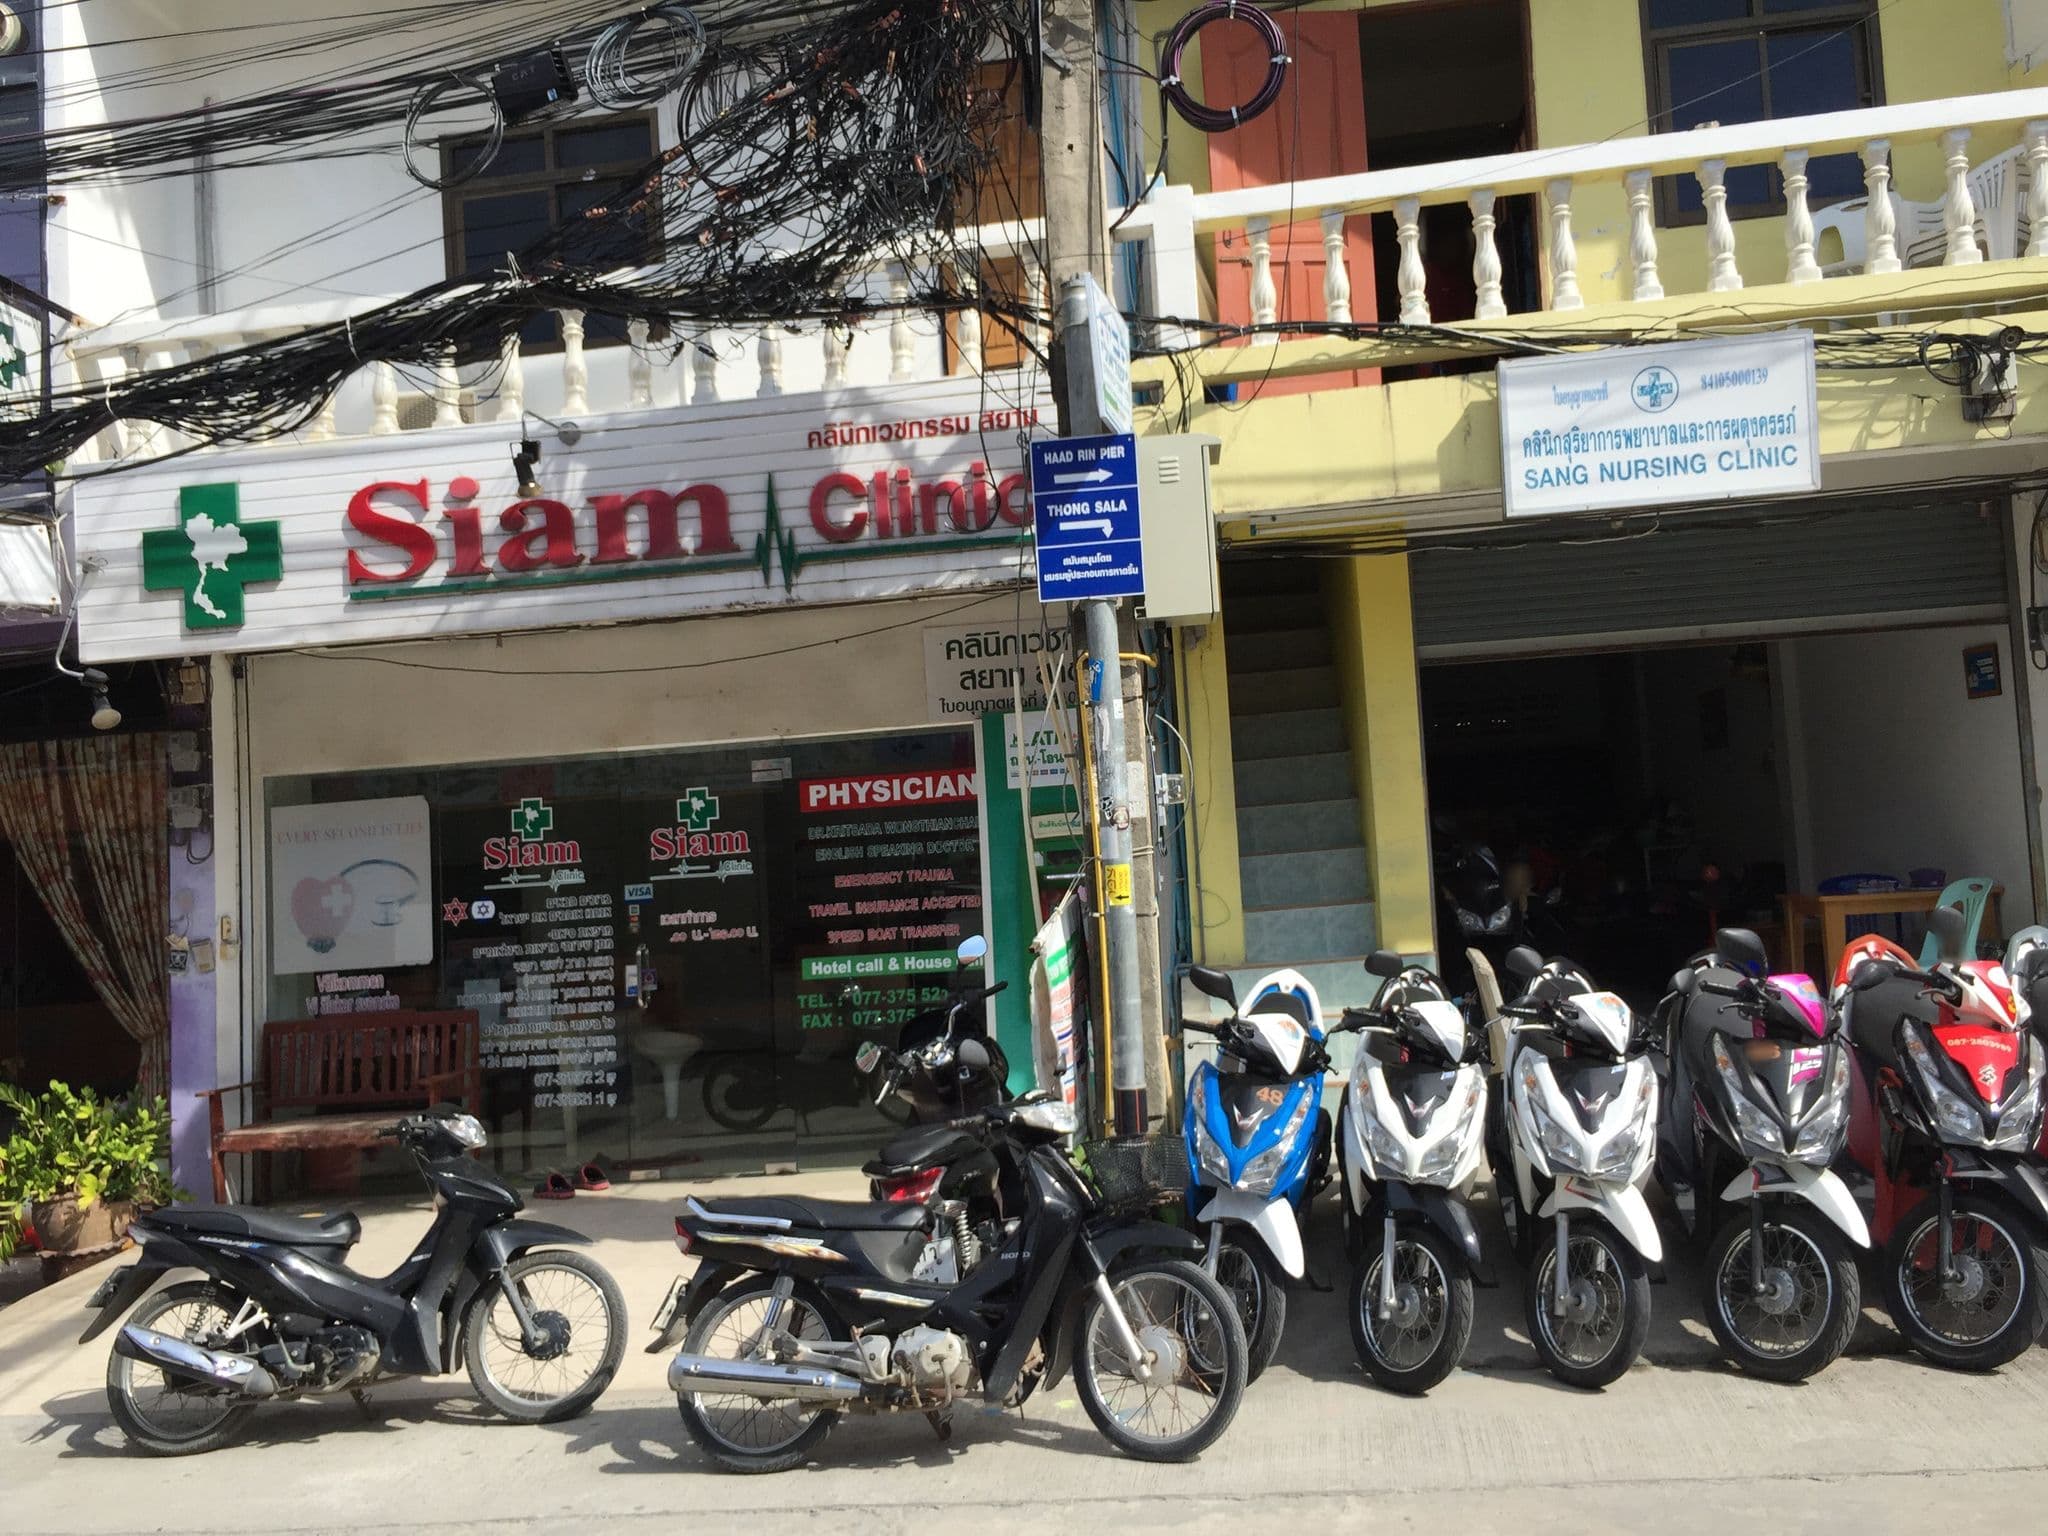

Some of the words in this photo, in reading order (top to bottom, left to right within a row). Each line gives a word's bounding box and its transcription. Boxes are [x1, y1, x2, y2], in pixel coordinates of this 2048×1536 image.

[806, 413, 971, 449] คลินิกเวชกรรม
[979, 406, 1039, 431] สยาม
[1044, 451, 1074, 465] HAAD
[1078, 449, 1096, 462] RIN
[1100, 446, 1126, 460] PIER
[1524, 464, 1589, 490] SANG
[1600, 454, 1707, 483] NURSING
[1717, 445, 1799, 472] CLINIC
[1047, 503, 1090, 517] THONG
[1095, 499, 1128, 514] SALA
[346, 476, 742, 586] Siam
[808, 460, 1035, 543] Clinic
[808, 773, 978, 807] PHYSICIAN
[483, 836, 582, 871] Siam
[650, 826, 751, 862] Siam
[815, 845, 864, 862] ENGLISH
[867, 842, 924, 858] SPEAKING
[555, 869, 586, 881] Clinic
[723, 860, 753, 873] Clinic
[834, 870, 904, 888] EMERGENCY
[907, 867, 955, 882] TRAUMA
[628, 886, 652, 898] VISA
[808, 902, 853, 918] TRAVEL
[856, 898, 919, 914] INSURANCE
[921, 895, 982, 911] ACCEPTED
[827, 929, 865, 944] SPEED
[867, 926, 899, 942] BOAT
[900, 923, 961, 939] TRANSFER
[811, 959, 852, 976] Hotel
[856, 957, 884, 973] call
[888, 957, 900, 971] &
[904, 956, 952, 971] House
[851, 988, 917, 1006] 077-375
[802, 1013, 833, 1029] FAX
[1255, 1086, 1285, 1106] 48
